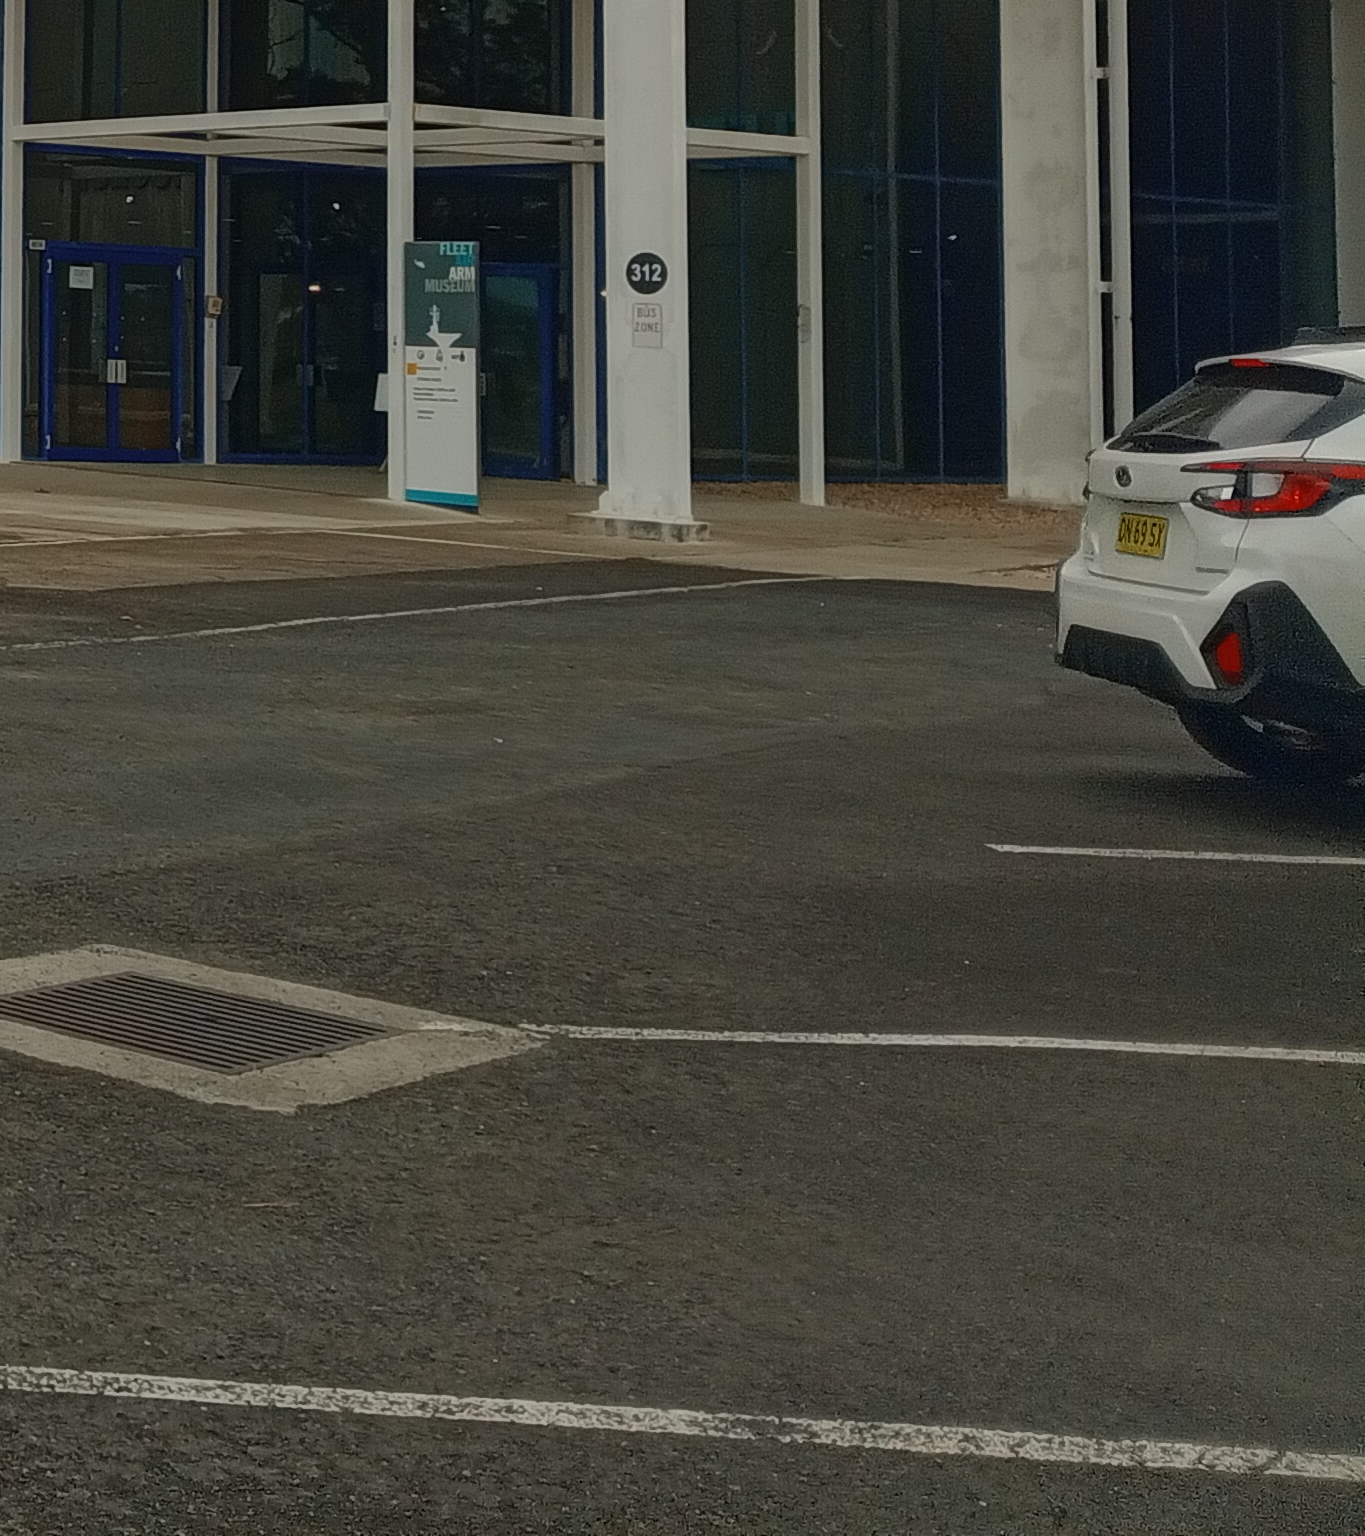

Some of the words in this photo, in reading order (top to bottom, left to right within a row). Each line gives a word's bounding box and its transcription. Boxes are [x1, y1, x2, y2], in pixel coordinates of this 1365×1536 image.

[439, 241, 474, 255] FLEET
[449, 266, 475, 281] ARM
[630, 263, 662, 282] 312
[425, 279, 475, 293] MUSEUM
[637, 307, 657, 318] BUS
[634, 321, 660, 333] ZONE
